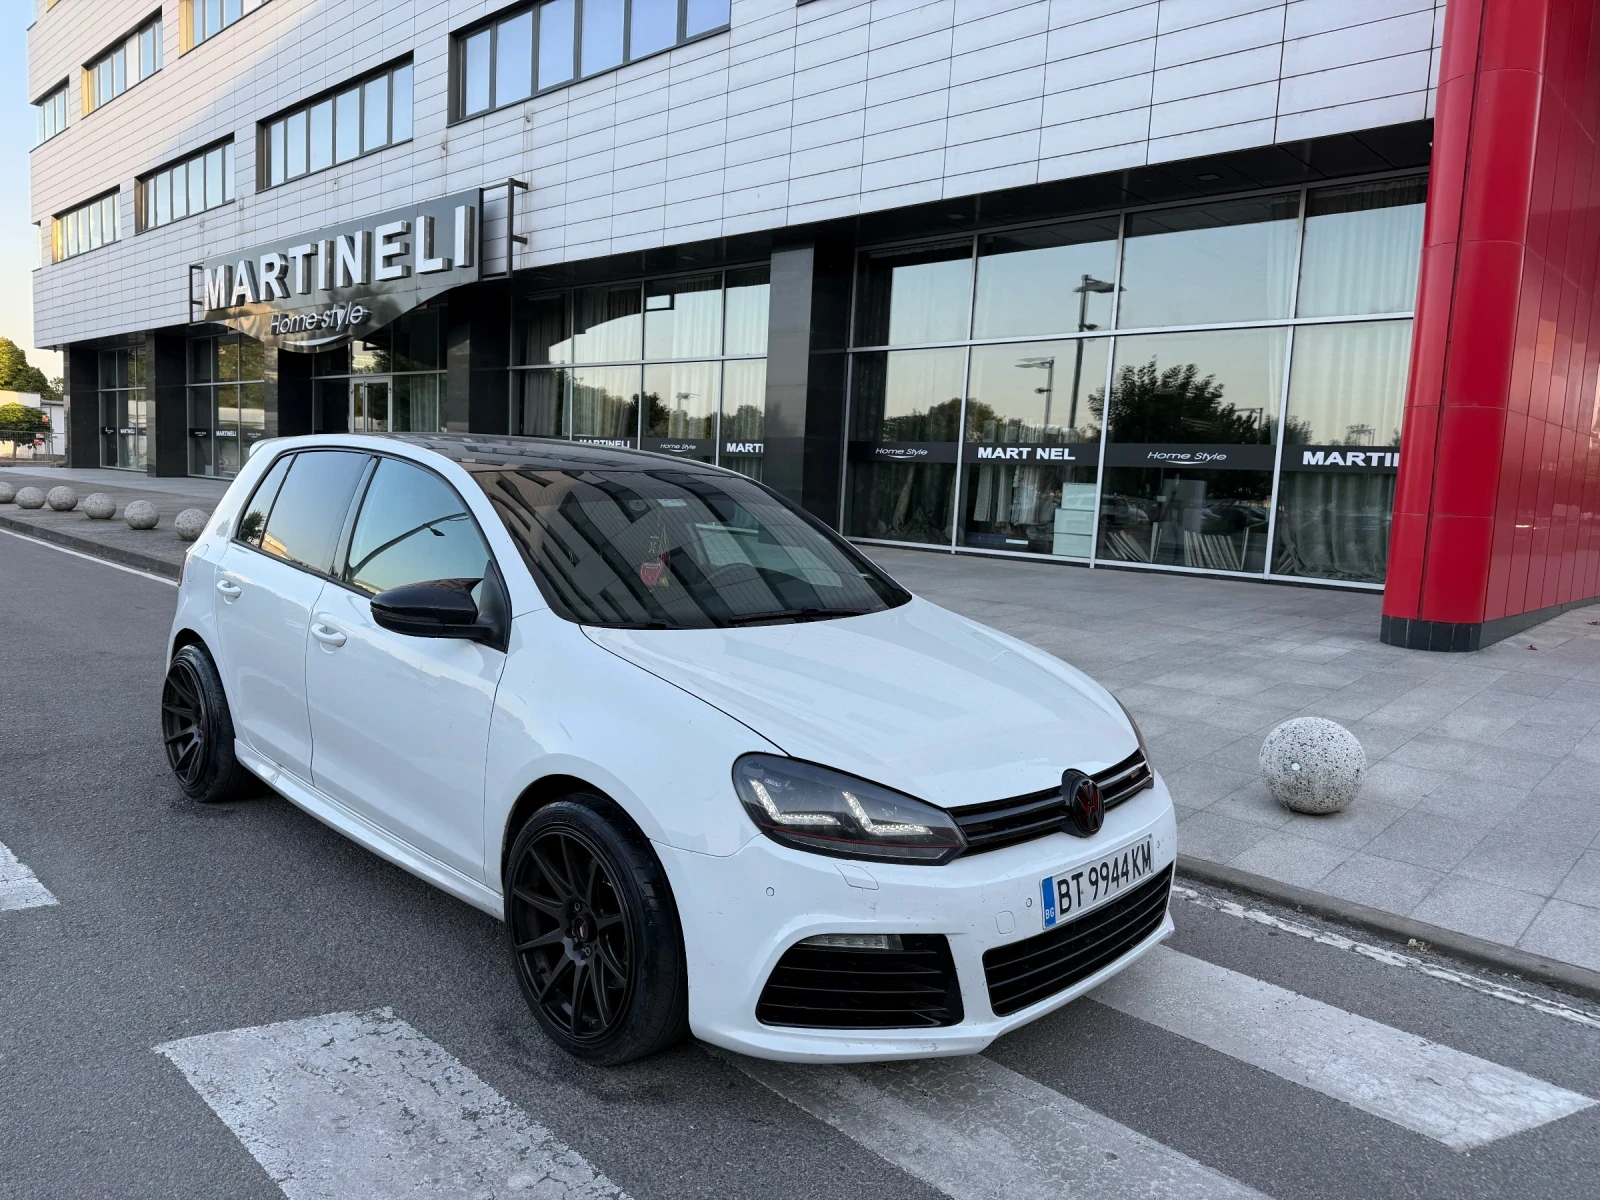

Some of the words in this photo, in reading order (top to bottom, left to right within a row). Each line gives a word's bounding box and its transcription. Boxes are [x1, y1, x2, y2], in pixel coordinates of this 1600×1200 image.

[204, 205, 475, 311] MARTINELI
[270, 312, 320, 335] Home
[321, 301, 367, 331] style
[681, 443, 697, 451] Style
[875, 447, 904, 455] Home
[906, 448, 928, 457] Style
[977, 446, 1031, 459] MART
[1035, 447, 1076, 460] NEL
[1147, 451, 1191, 460] Home
[1194, 452, 1227, 462] Style
[1057, 872, 1083, 915] BT
[1088, 852, 1130, 900] 9944
[1131, 841, 1152, 879] KM
[1045, 907, 1055, 920] BG
